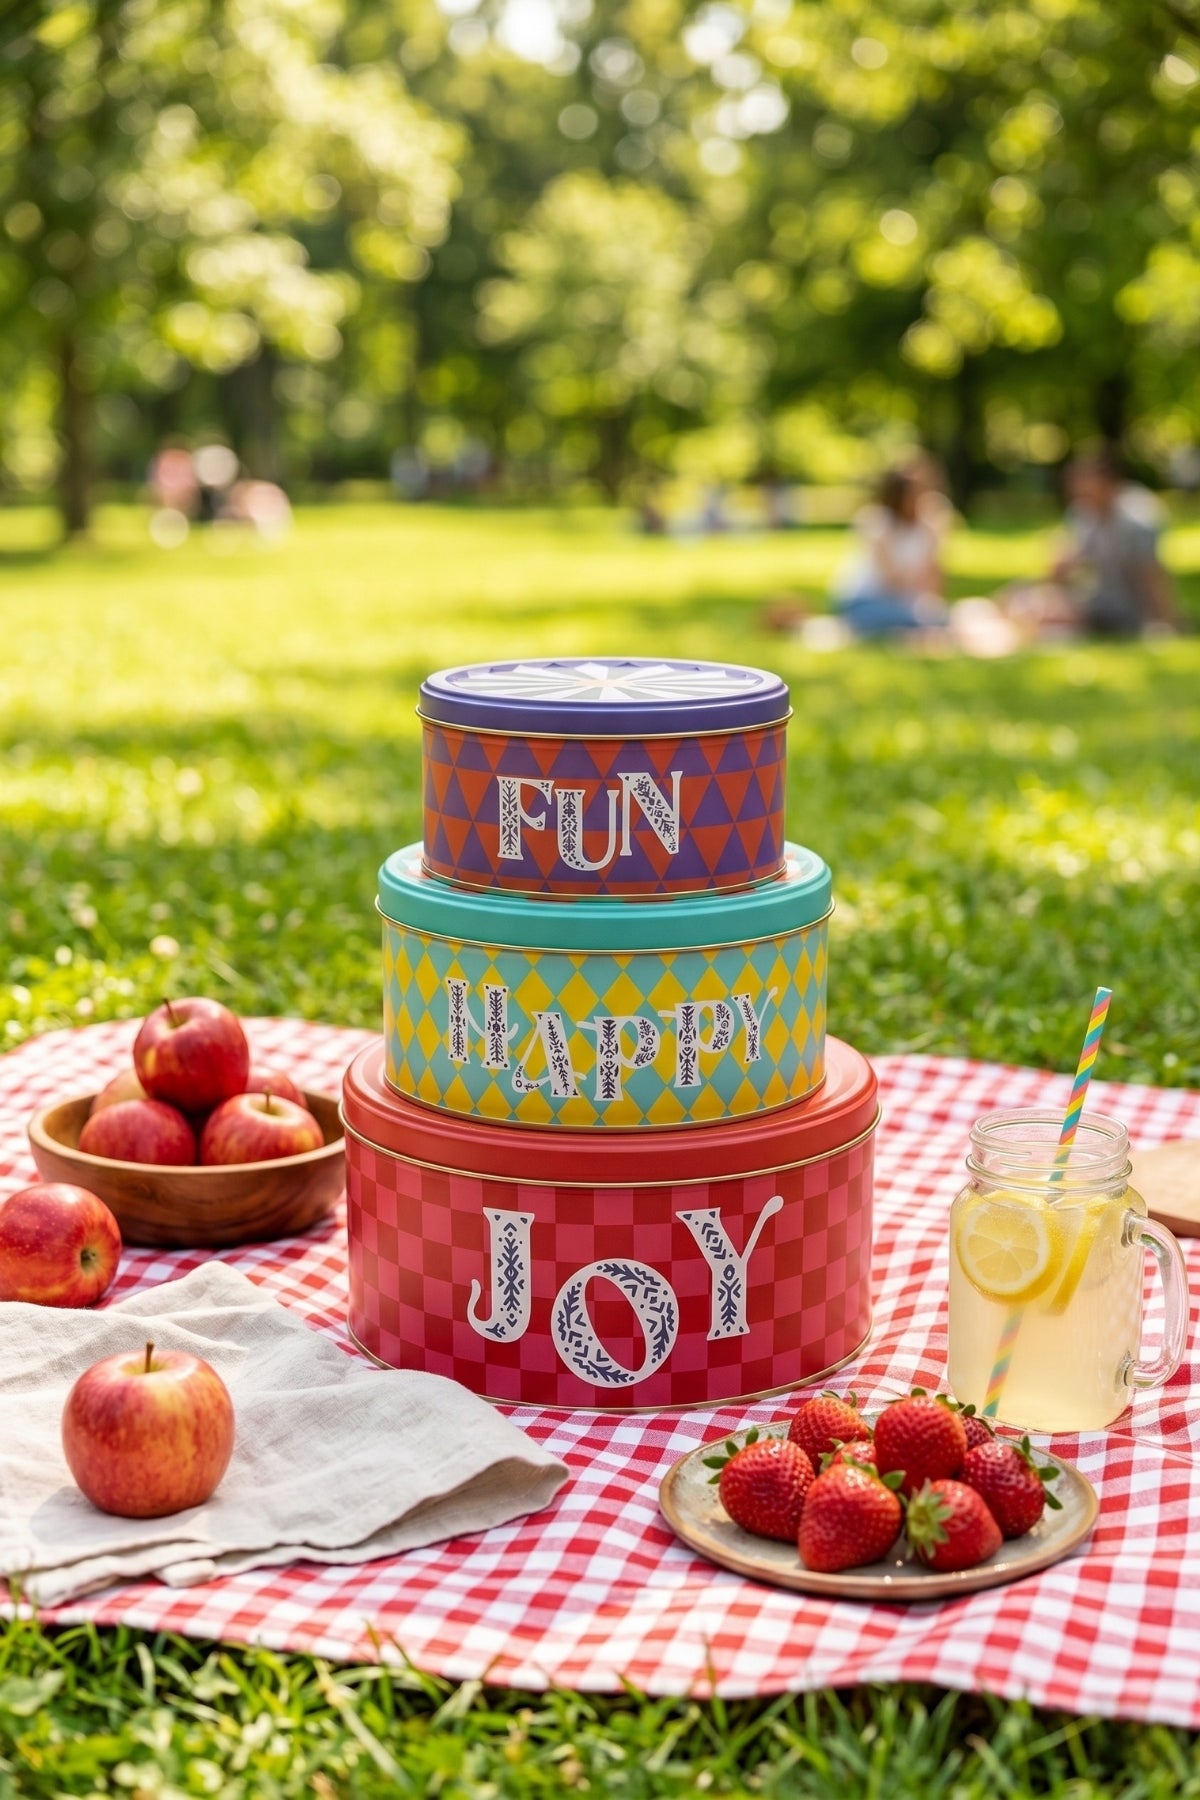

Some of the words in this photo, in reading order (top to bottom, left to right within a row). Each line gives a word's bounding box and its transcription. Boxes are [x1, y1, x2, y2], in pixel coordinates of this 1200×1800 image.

[496, 770, 683, 871] FUN
[444, 976, 779, 1102] HAPPY
[467, 1195, 784, 1388] JOY
